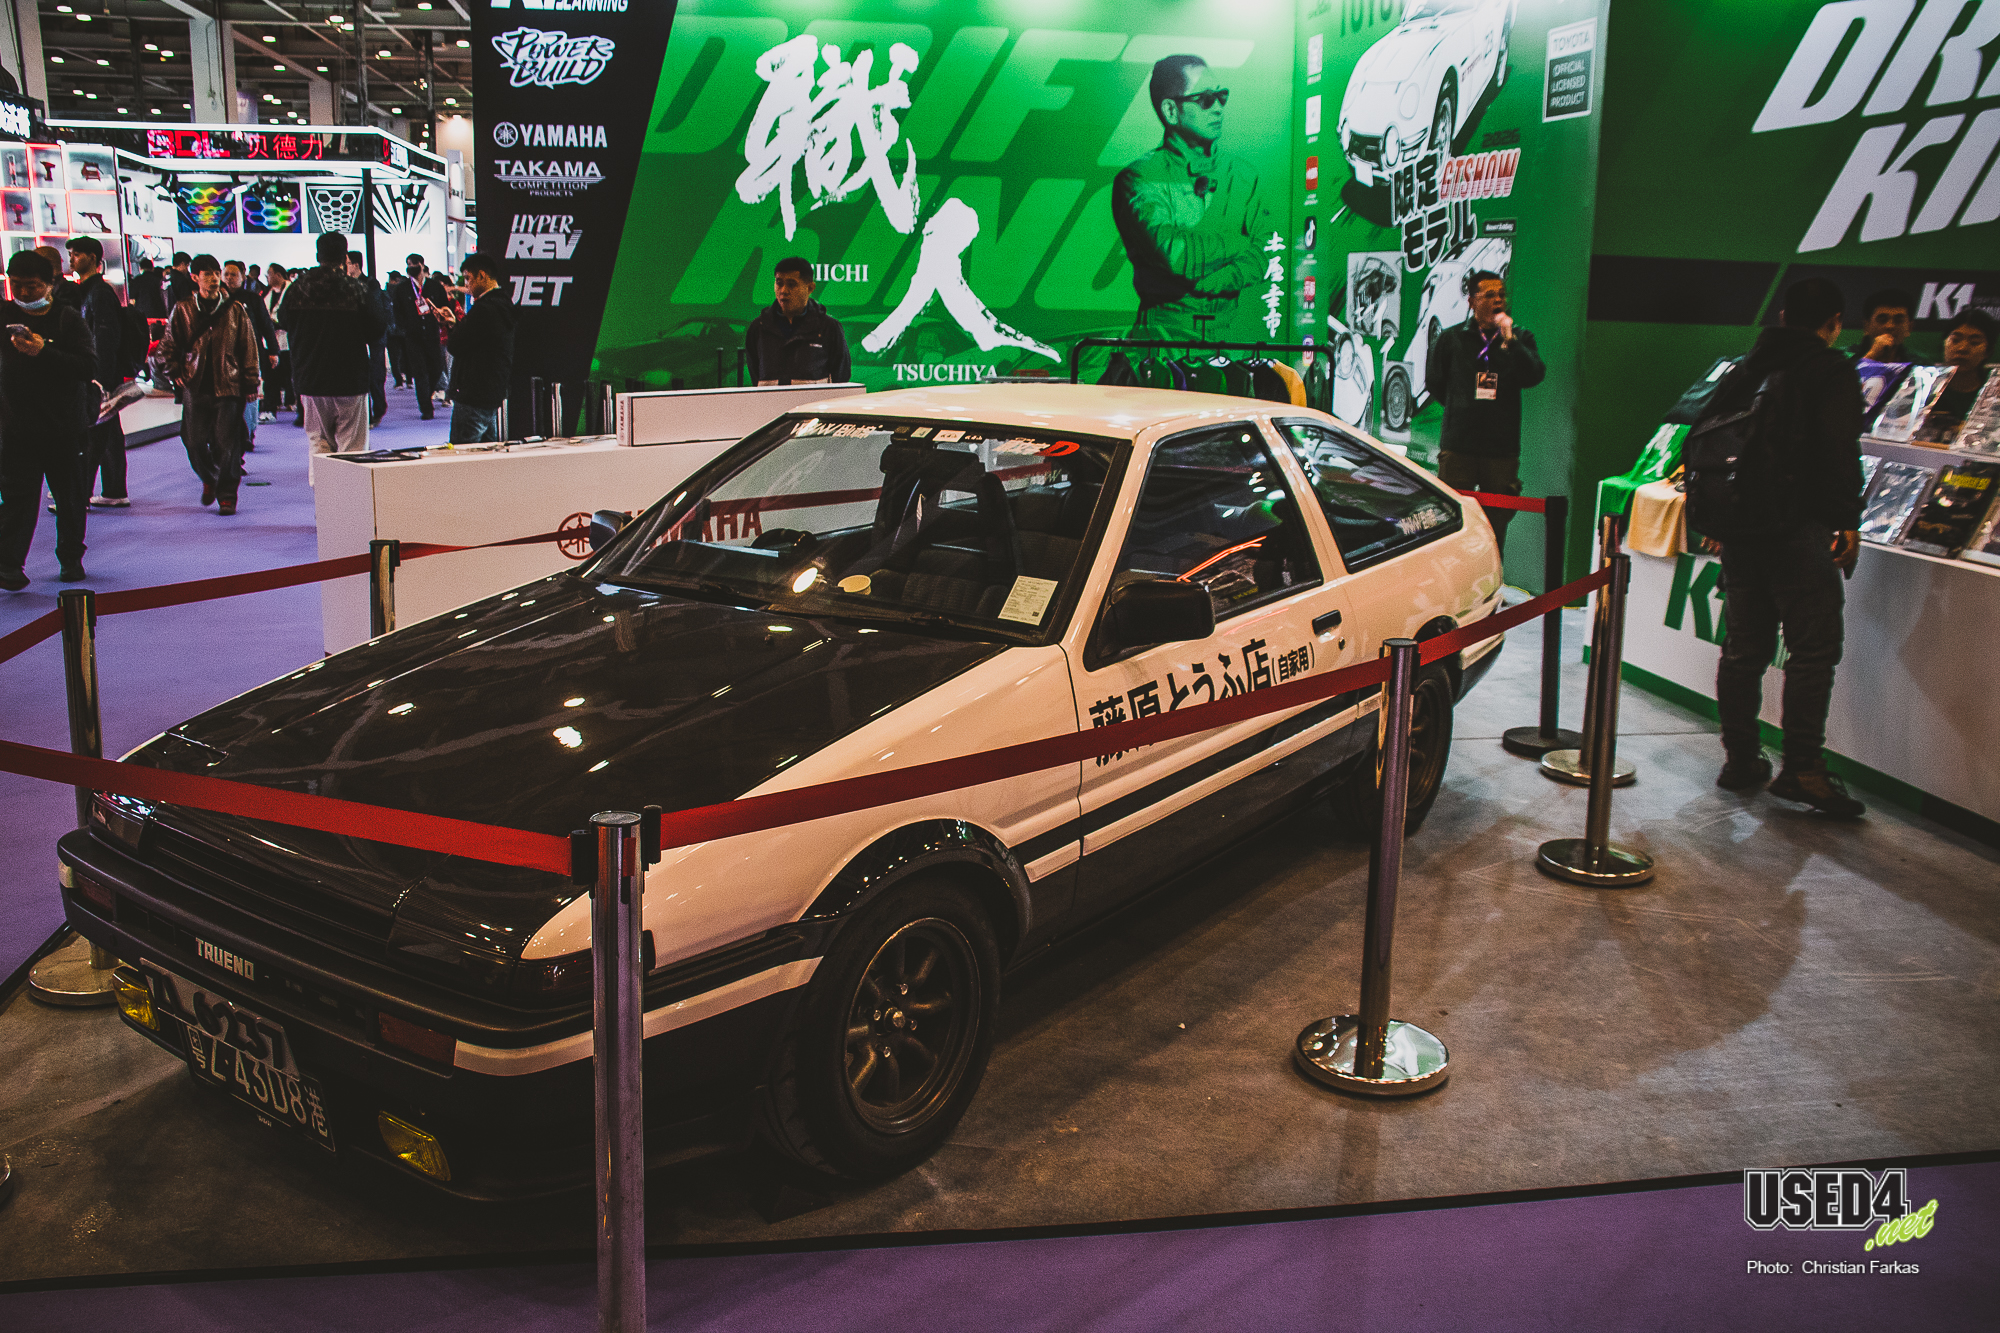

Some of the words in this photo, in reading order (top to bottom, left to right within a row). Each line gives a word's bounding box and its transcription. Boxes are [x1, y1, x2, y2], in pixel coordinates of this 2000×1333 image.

[492, 26, 616, 63] POWER
[1553, 31, 1590, 51] TOYOTA
[510, 57, 607, 89] BUILD
[1552, 59, 1585, 77] OFFICIAL
[1751, 0, 2000, 133] DR
[1551, 75, 1586, 93] LICENSED
[1550, 91, 1586, 107] PRODUCT
[248, 133, 323, 160] 贝德力
[519, 123, 608, 148] YAMAHA
[494, 160, 602, 177] TAKAMA
[1440, 149, 1521, 201] GTSHOW
[510, 181, 588, 190] COMPETITION
[529, 189, 574, 197] PRODUCTS
[511, 213, 574, 234] HYPER
[504, 230, 583, 260] REV
[811, 263, 869, 282] IICHI
[1261, 231, 1286, 339] 土屋圭市
[509, 275, 574, 306] JET
[1915, 282, 1976, 319] K1
[893, 363, 998, 382] TSUCHIYA
[195, 937, 255, 981] TRUENO
